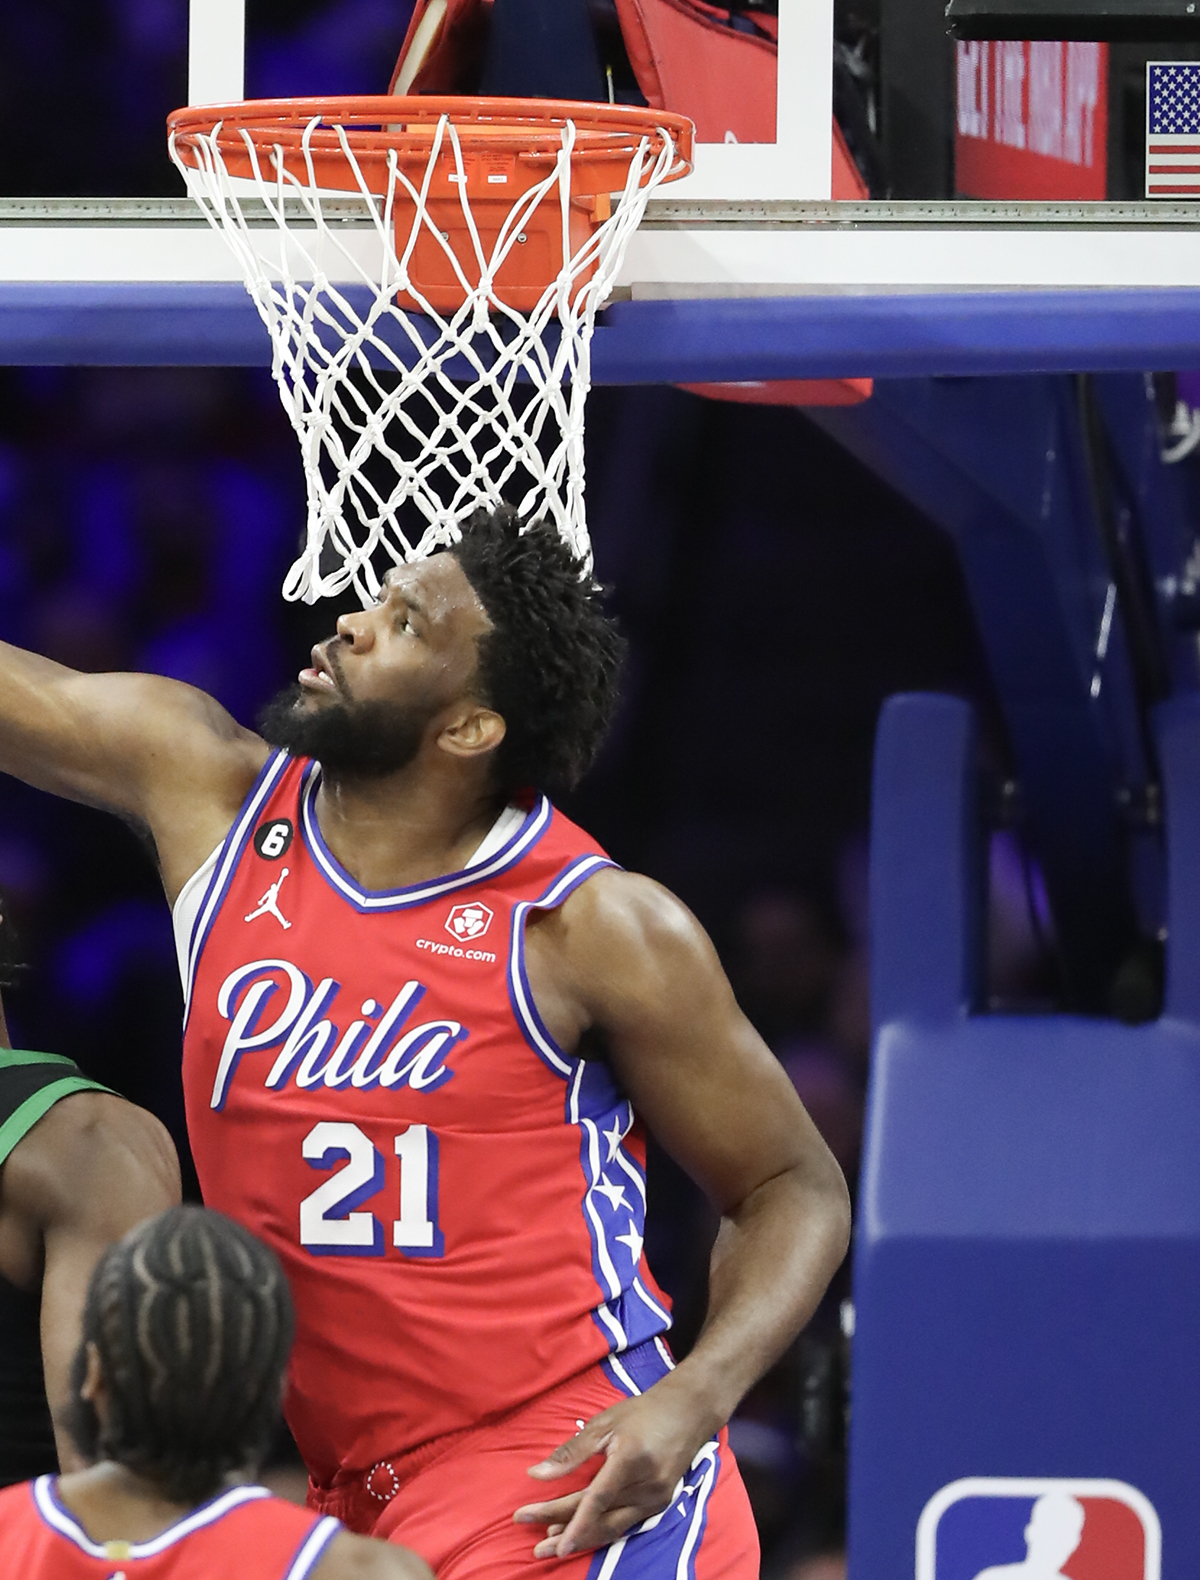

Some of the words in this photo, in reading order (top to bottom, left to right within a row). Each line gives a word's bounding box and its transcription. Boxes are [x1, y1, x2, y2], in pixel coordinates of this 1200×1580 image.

[261, 823, 290, 857] 6
[415, 937, 497, 964] crypto.com
[209, 958, 470, 1113] Phila
[299, 1121, 446, 1258] 21
